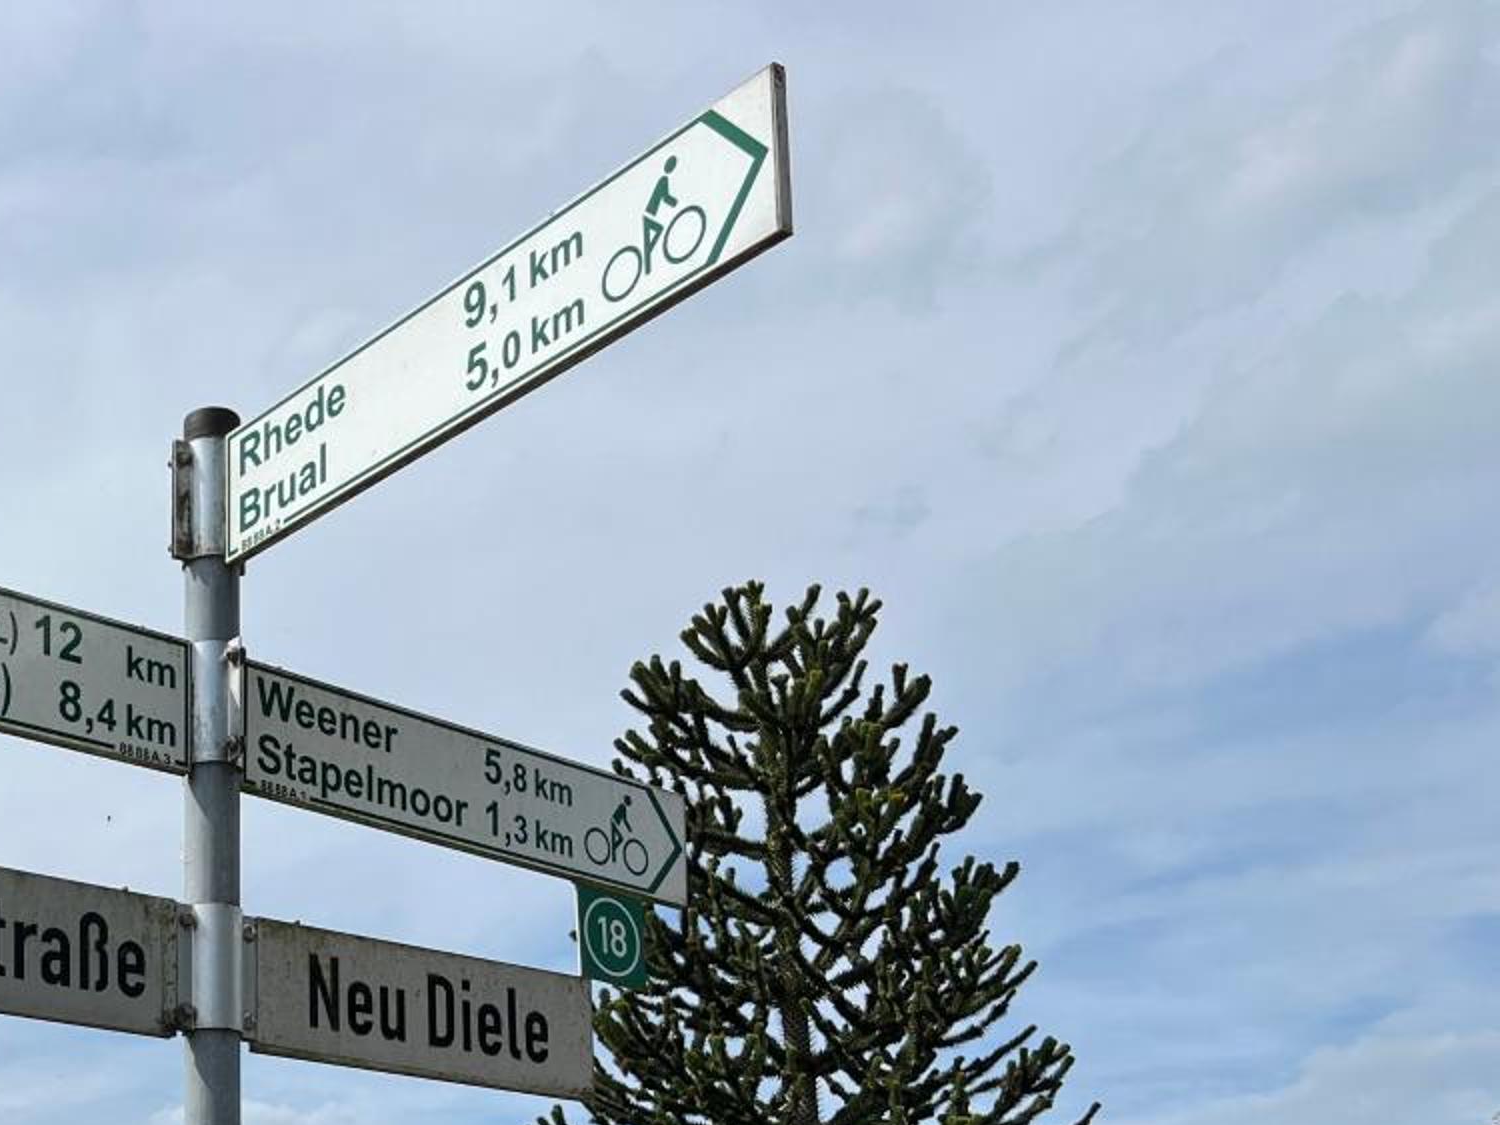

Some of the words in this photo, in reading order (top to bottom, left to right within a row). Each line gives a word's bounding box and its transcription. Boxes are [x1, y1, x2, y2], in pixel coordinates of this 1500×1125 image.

[239, 384, 346, 477] Rhede
[463, 264, 517, 329] 9,1
[529, 231, 583, 289] km
[239, 443, 327, 533] Brual
[466, 331, 521, 392] 5,0
[531, 299, 585, 354] km
[35, 615, 83, 665] 12
[126, 645, 177, 690] km
[58, 681, 117, 736] 8,4
[126, 703, 177, 749] km
[256, 675, 398, 753] Weener
[484, 748, 527, 795] 5,8
[534, 768, 573, 807] km
[257, 733, 469, 827] Stapelmoor
[484, 800, 528, 849] 1,3
[535, 819, 573, 858] km
[597, 915, 628, 959] 18
[308, 952, 407, 1044] Neu
[427, 973, 550, 1065] Diele
